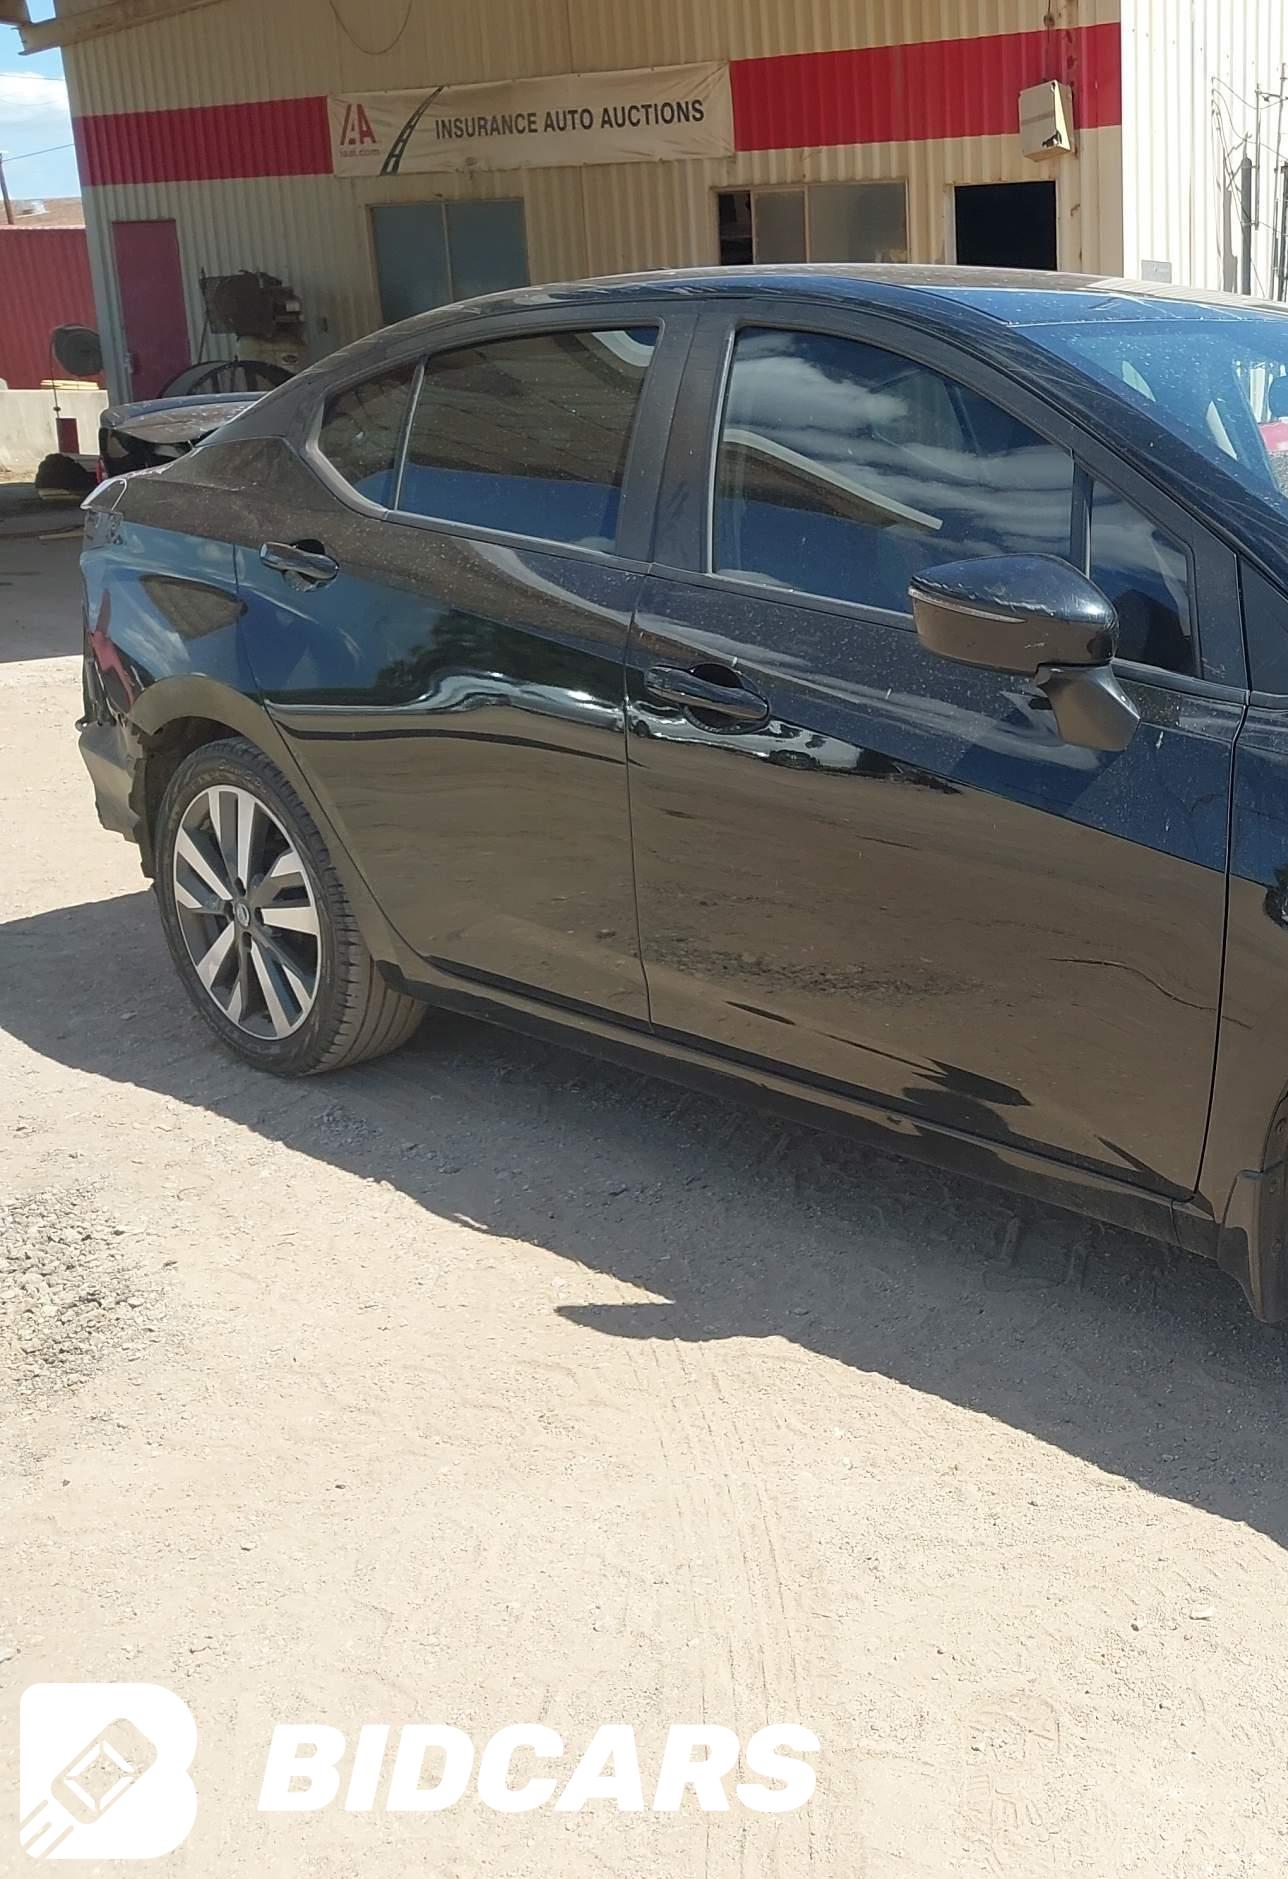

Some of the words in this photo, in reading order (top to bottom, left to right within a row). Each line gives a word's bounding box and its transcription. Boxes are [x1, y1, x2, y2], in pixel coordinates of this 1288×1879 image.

[435, 112, 538, 140] INSURANCE
[543, 108, 594, 133] AUTO
[600, 99, 705, 129] AUCTIONS
